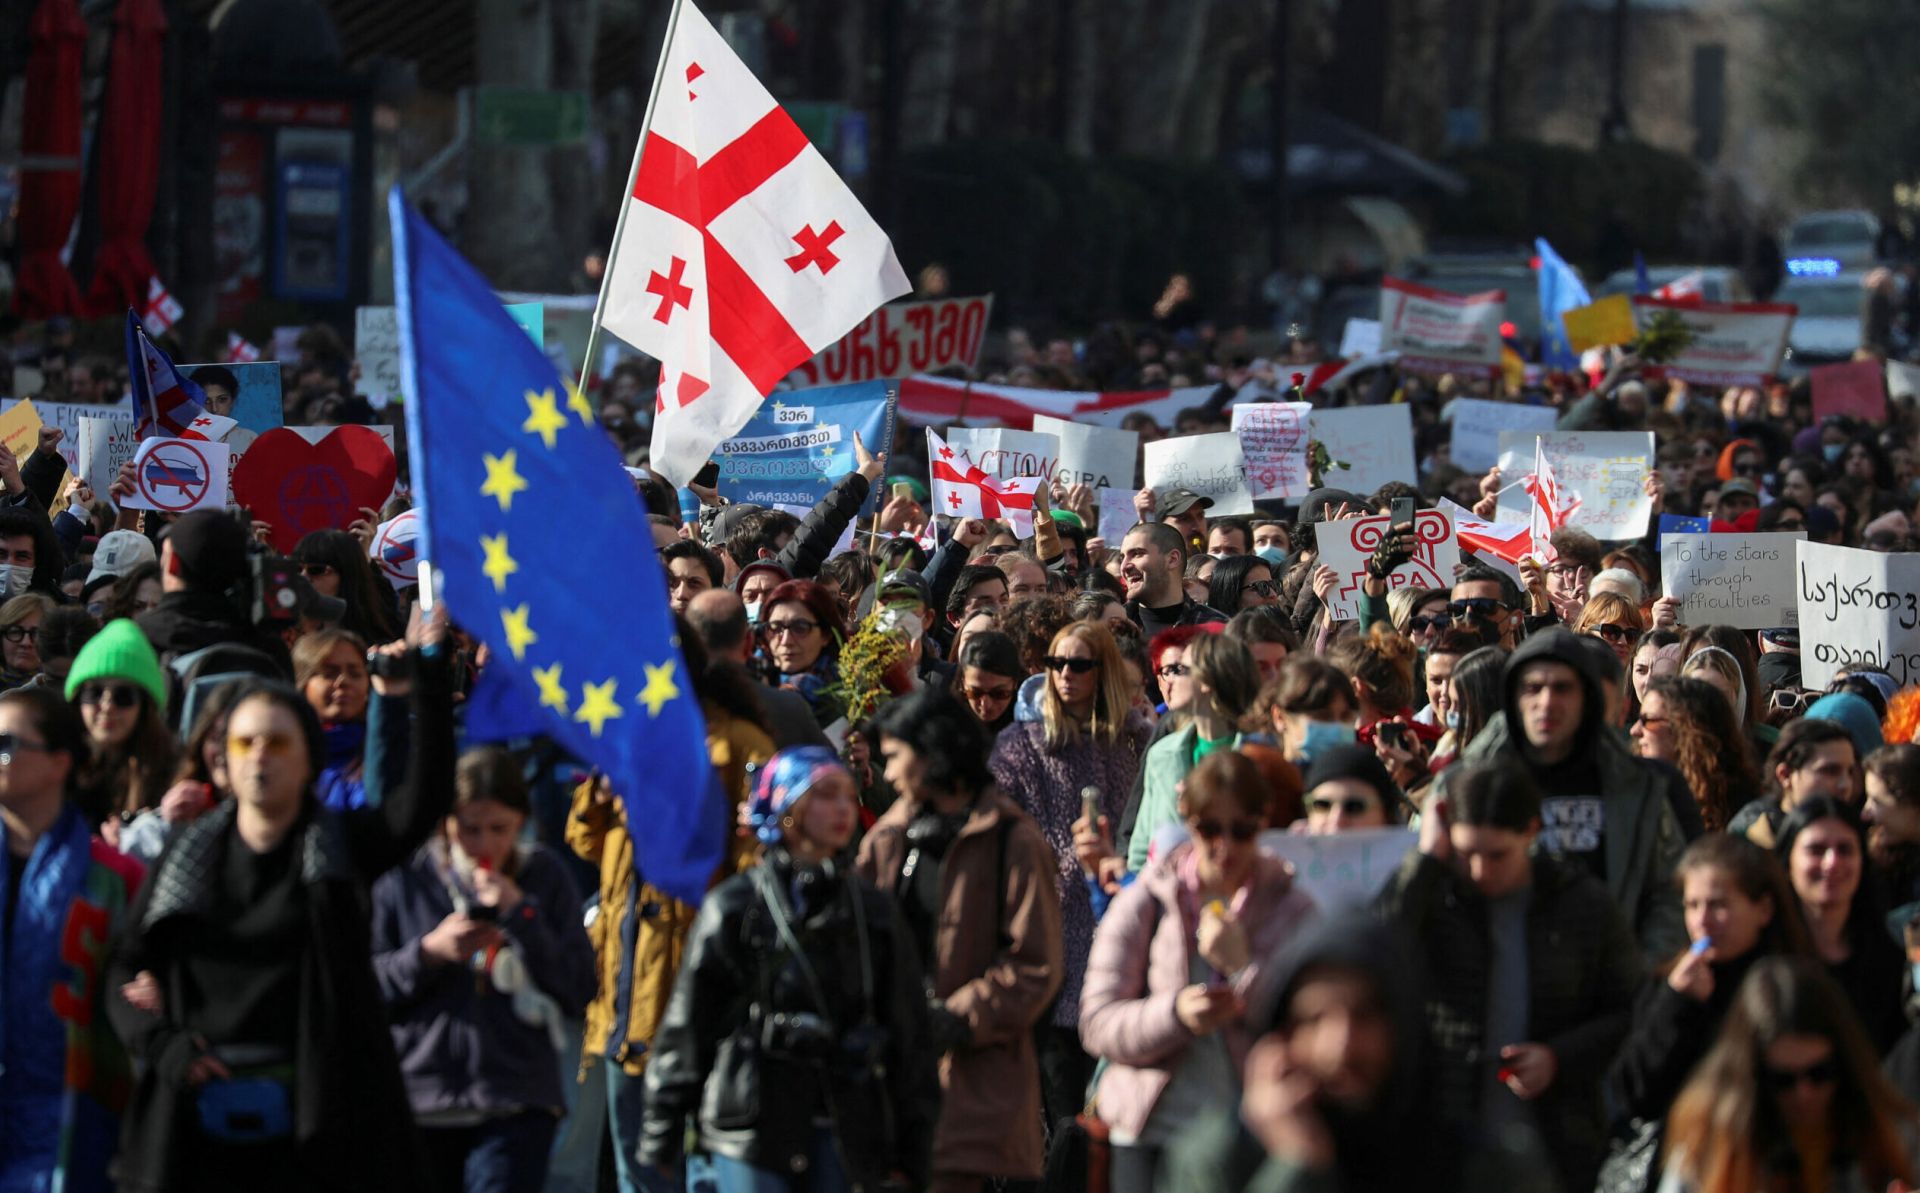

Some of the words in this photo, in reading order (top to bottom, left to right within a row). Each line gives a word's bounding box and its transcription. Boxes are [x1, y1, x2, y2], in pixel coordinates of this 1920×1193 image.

[779, 409, 808, 423] ვერ
[721, 430, 831, 454] წაგვართმევთ
[1058, 468, 1112, 489] GIPA
[746, 490, 815, 504] არჩევანს
[1670, 542, 1692, 562] To
[1698, 540, 1728, 561] the
[1734, 540, 1779, 561] stars
[1689, 566, 1752, 593] through
[1801, 560, 1920, 630] საქართვ
